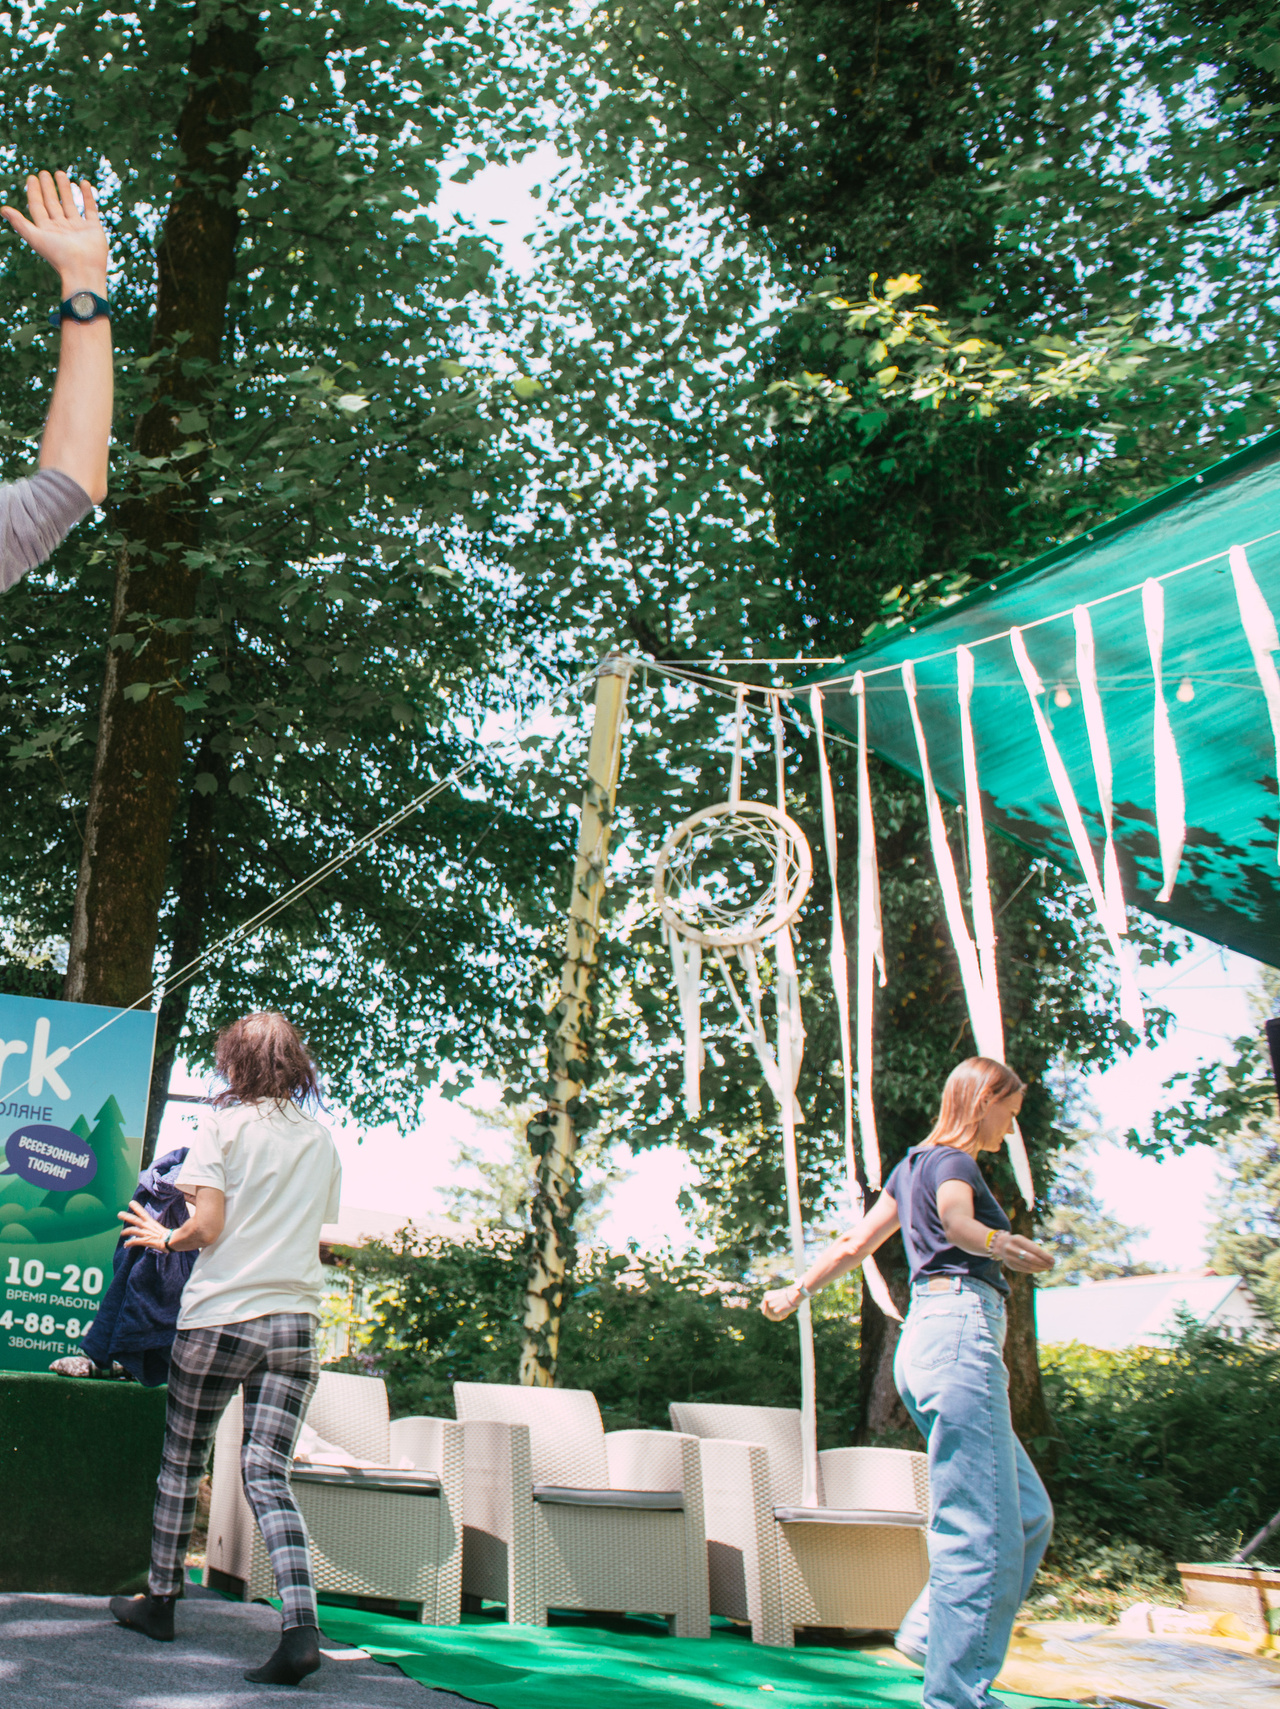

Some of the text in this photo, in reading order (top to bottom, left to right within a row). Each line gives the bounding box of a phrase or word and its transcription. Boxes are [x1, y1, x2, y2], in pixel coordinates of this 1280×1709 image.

[18, 1135, 90, 1169] ВСЕСЕЗОННЫЙ
[27, 1156, 72, 1180] ТЮБИНГ
[6, 1288, 100, 1311] ВРЕМЯ РАБОТЫ
[8, 1336, 65, 1354] ЗВОНИТЕ
